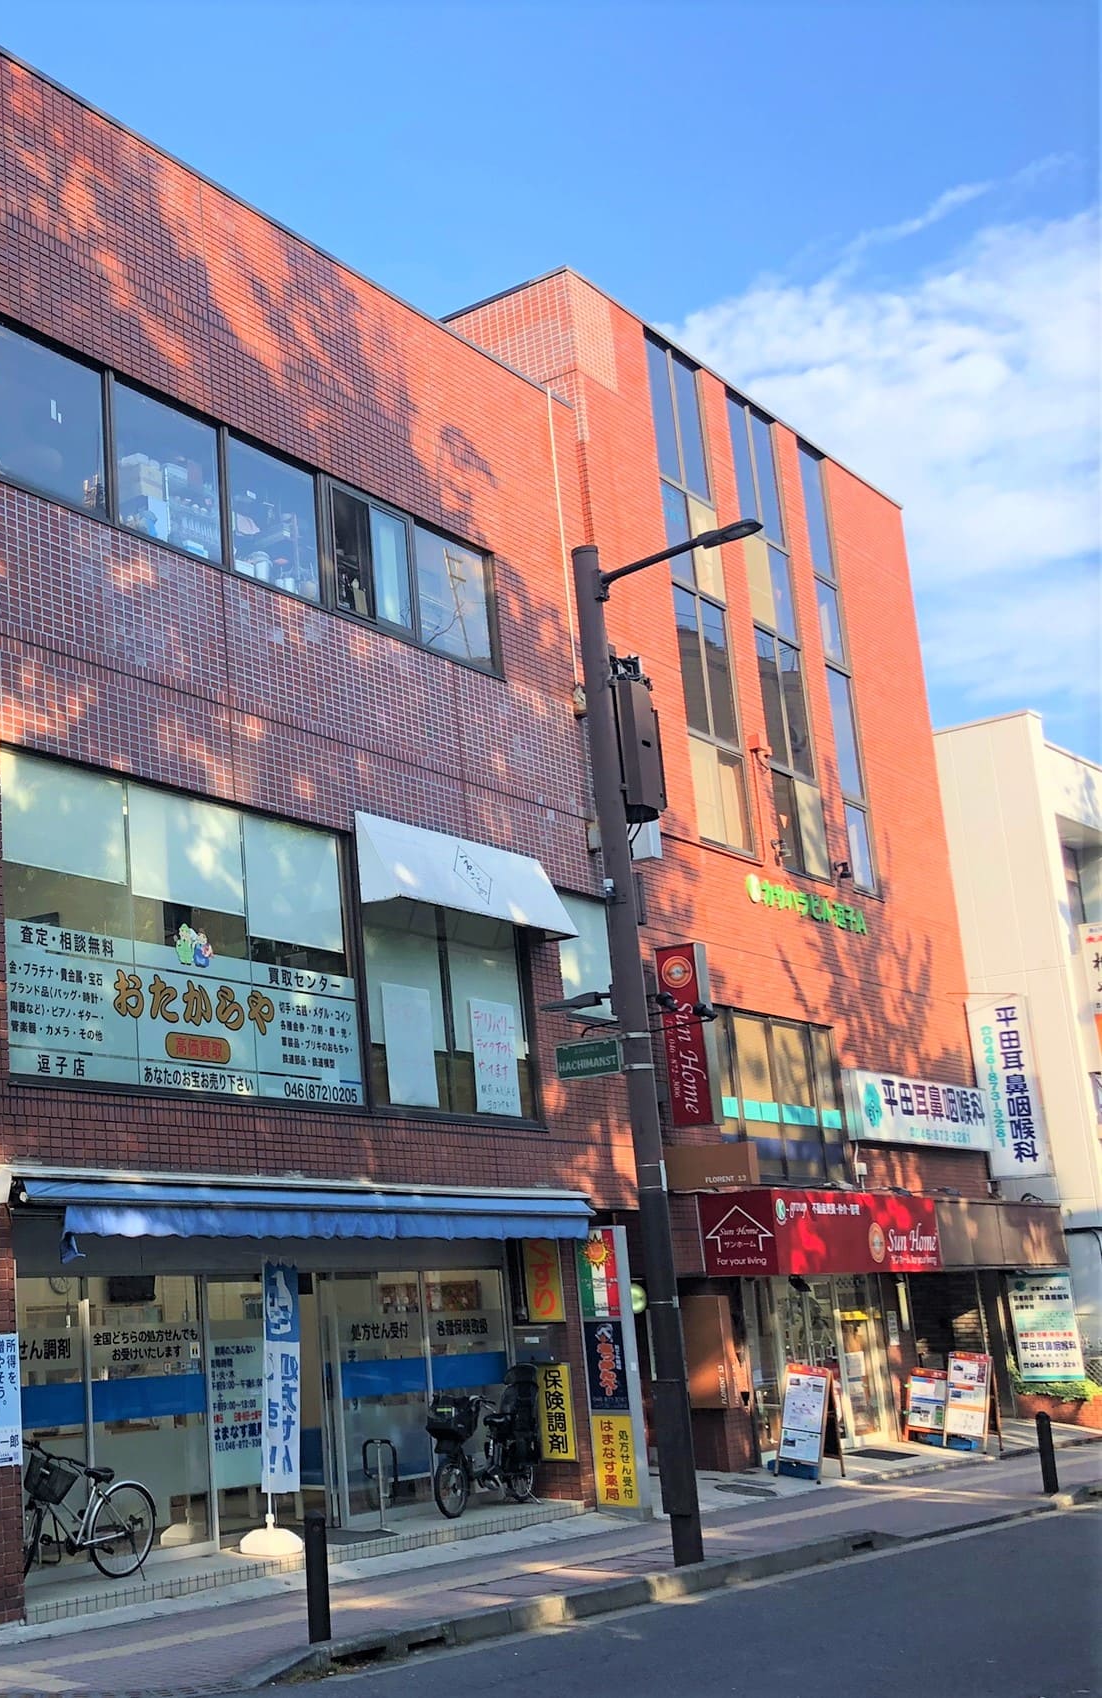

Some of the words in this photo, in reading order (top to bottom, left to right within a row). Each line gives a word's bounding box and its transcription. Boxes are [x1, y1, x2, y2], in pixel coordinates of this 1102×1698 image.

[20, 924, 115, 958] 査定・相談無料
[268, 966, 341, 992] 買取センター
[113, 968, 275, 1036] おたからや
[673, 1000, 694, 1042] Sun
[175, 1036, 224, 1061] 高価買取
[37, 1053, 86, 1077] 逗子店
[143, 1066, 255, 1093] あなたのお宝お売り下さい
[284, 1081, 358, 1104] 046(872)0205
[679, 1049, 707, 1114] Home
[995, 1006, 1039, 1164] 平田耳鼻咽喉科
[881, 1079, 986, 1127] 平田耳鼻咽喉科
[705, 1175, 734, 1184] FLORENT
[718, 1227, 734, 1236] Sun
[736, 1224, 759, 1235] Home
[887, 1228, 906, 1252] Sun
[908, 1222, 937, 1251] Home
[724, 1240, 757, 1248] サンホーム
[717, 1257, 728, 1265] For
[729, 1258, 746, 1266] your
[747, 1256, 767, 1266] living
[93, 1328, 198, 1346] 全国どちらの処方せんでも
[351, 1320, 409, 1341] 処方せん受付
[436, 1318, 489, 1337] 各種保険取扱
[6, 1339, 17, 1391] 所得を、
[112, 1345, 182, 1362] お受けいたします
[543, 1369, 569, 1454] 保険調剤
[600, 1420, 620, 1501] はまなす薬局
[618, 1430, 634, 1499] 処方せん受付
